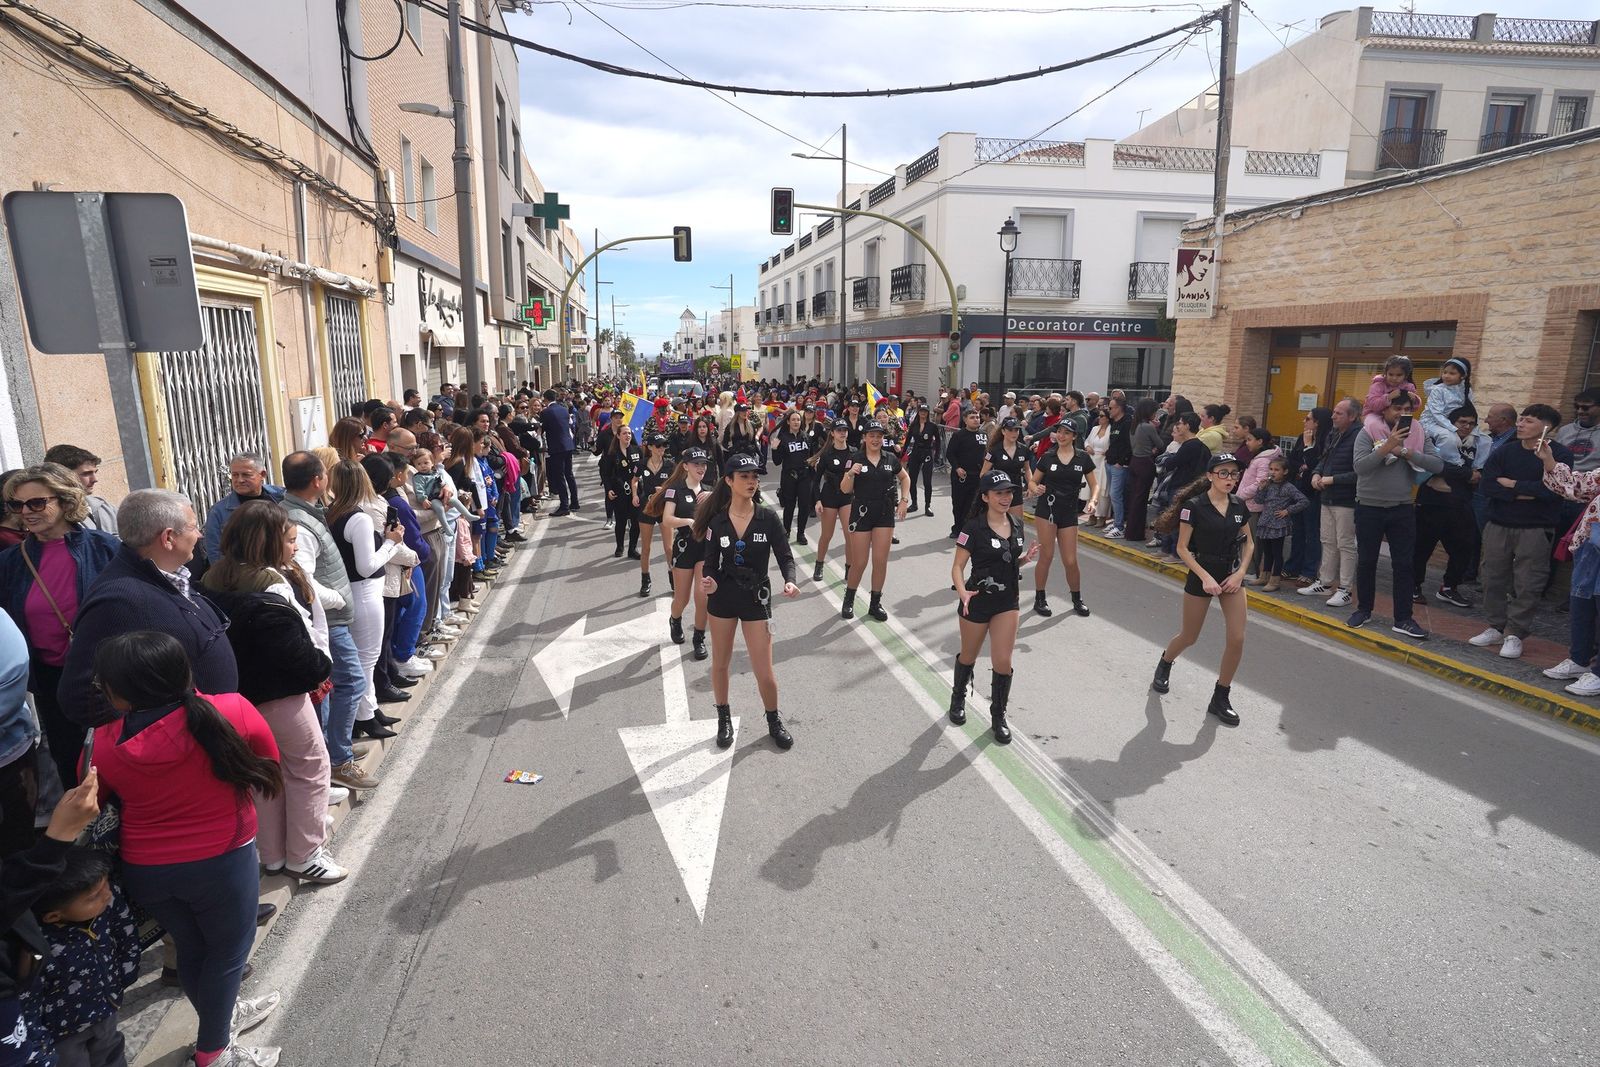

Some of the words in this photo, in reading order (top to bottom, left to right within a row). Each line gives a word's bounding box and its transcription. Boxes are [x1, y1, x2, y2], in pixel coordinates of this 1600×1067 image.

[1007, 318, 1085, 332] Decorator
[1093, 319, 1142, 333] Centre
[788, 441, 809, 453] DEA
[753, 533, 768, 543] DEA
